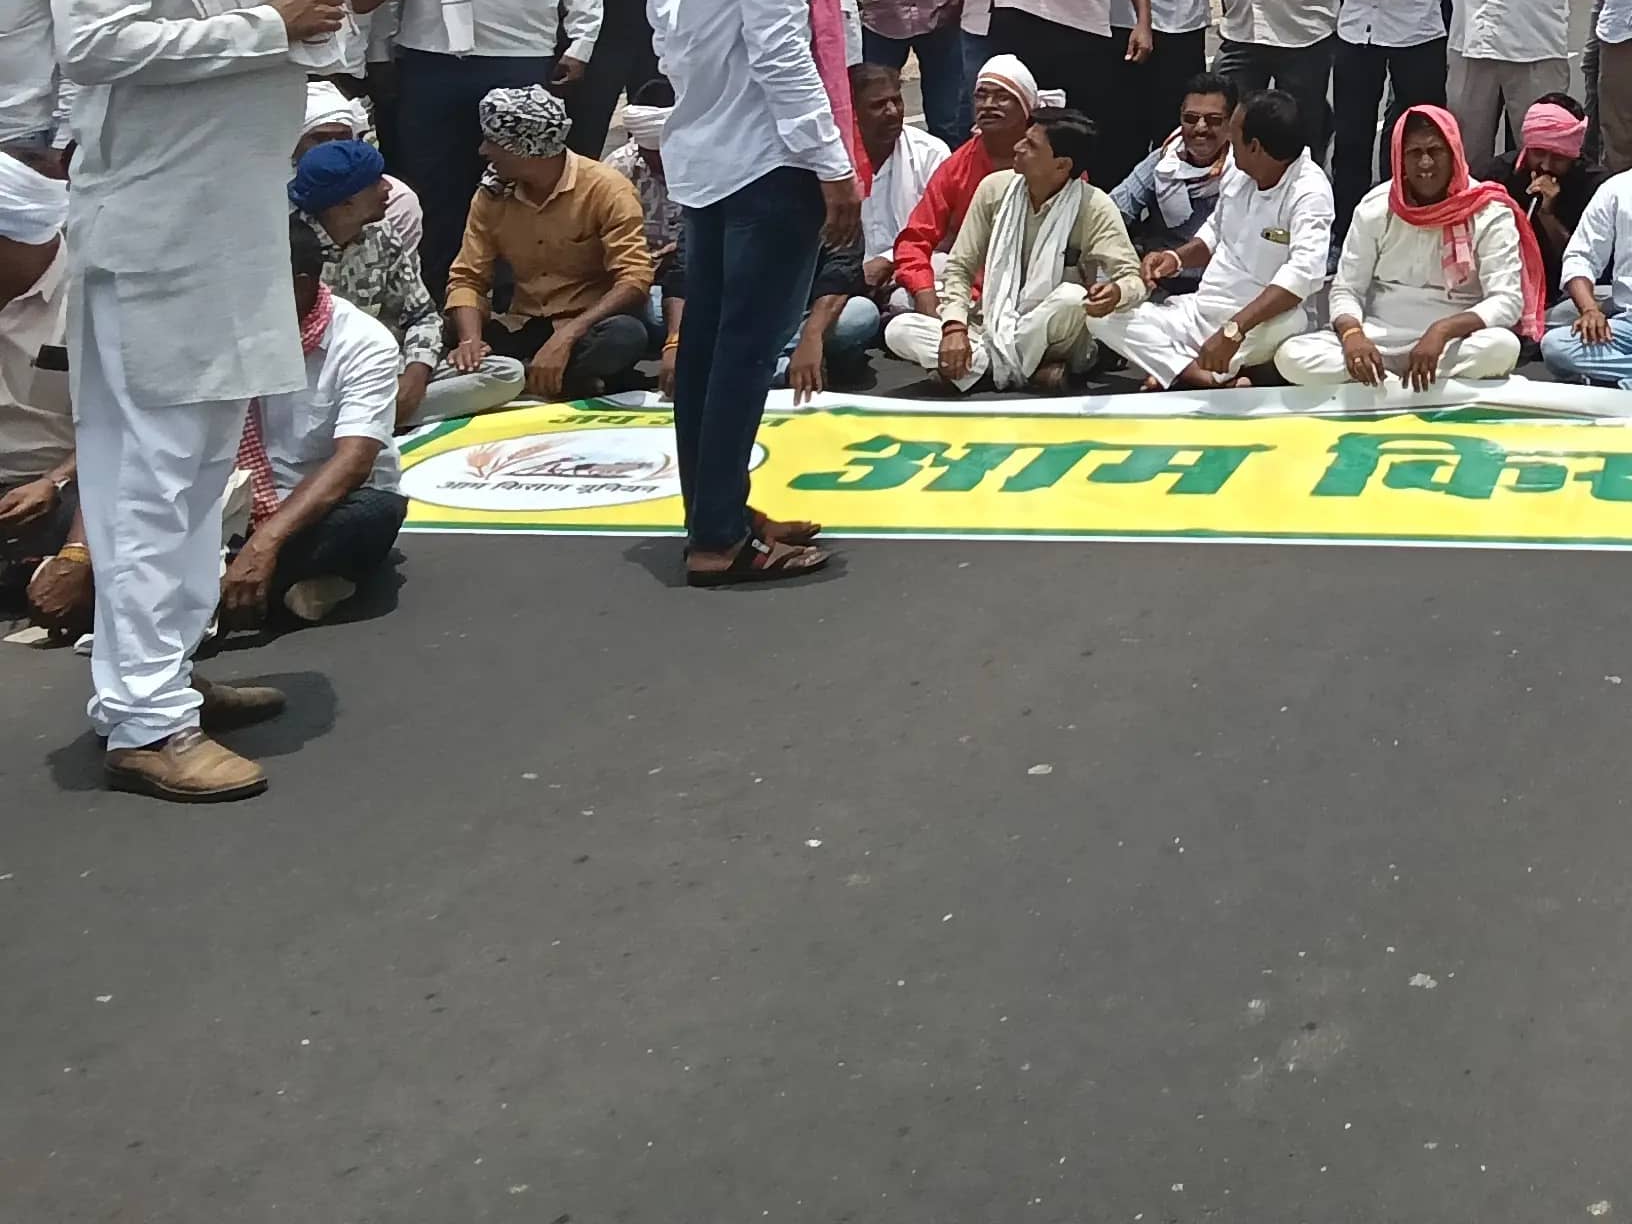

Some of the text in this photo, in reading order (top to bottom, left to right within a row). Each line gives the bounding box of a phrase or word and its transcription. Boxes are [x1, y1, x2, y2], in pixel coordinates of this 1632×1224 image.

[787, 434, 1275, 495] आम
[436, 481, 488, 489] आम
[491, 481, 572, 492] किसान
